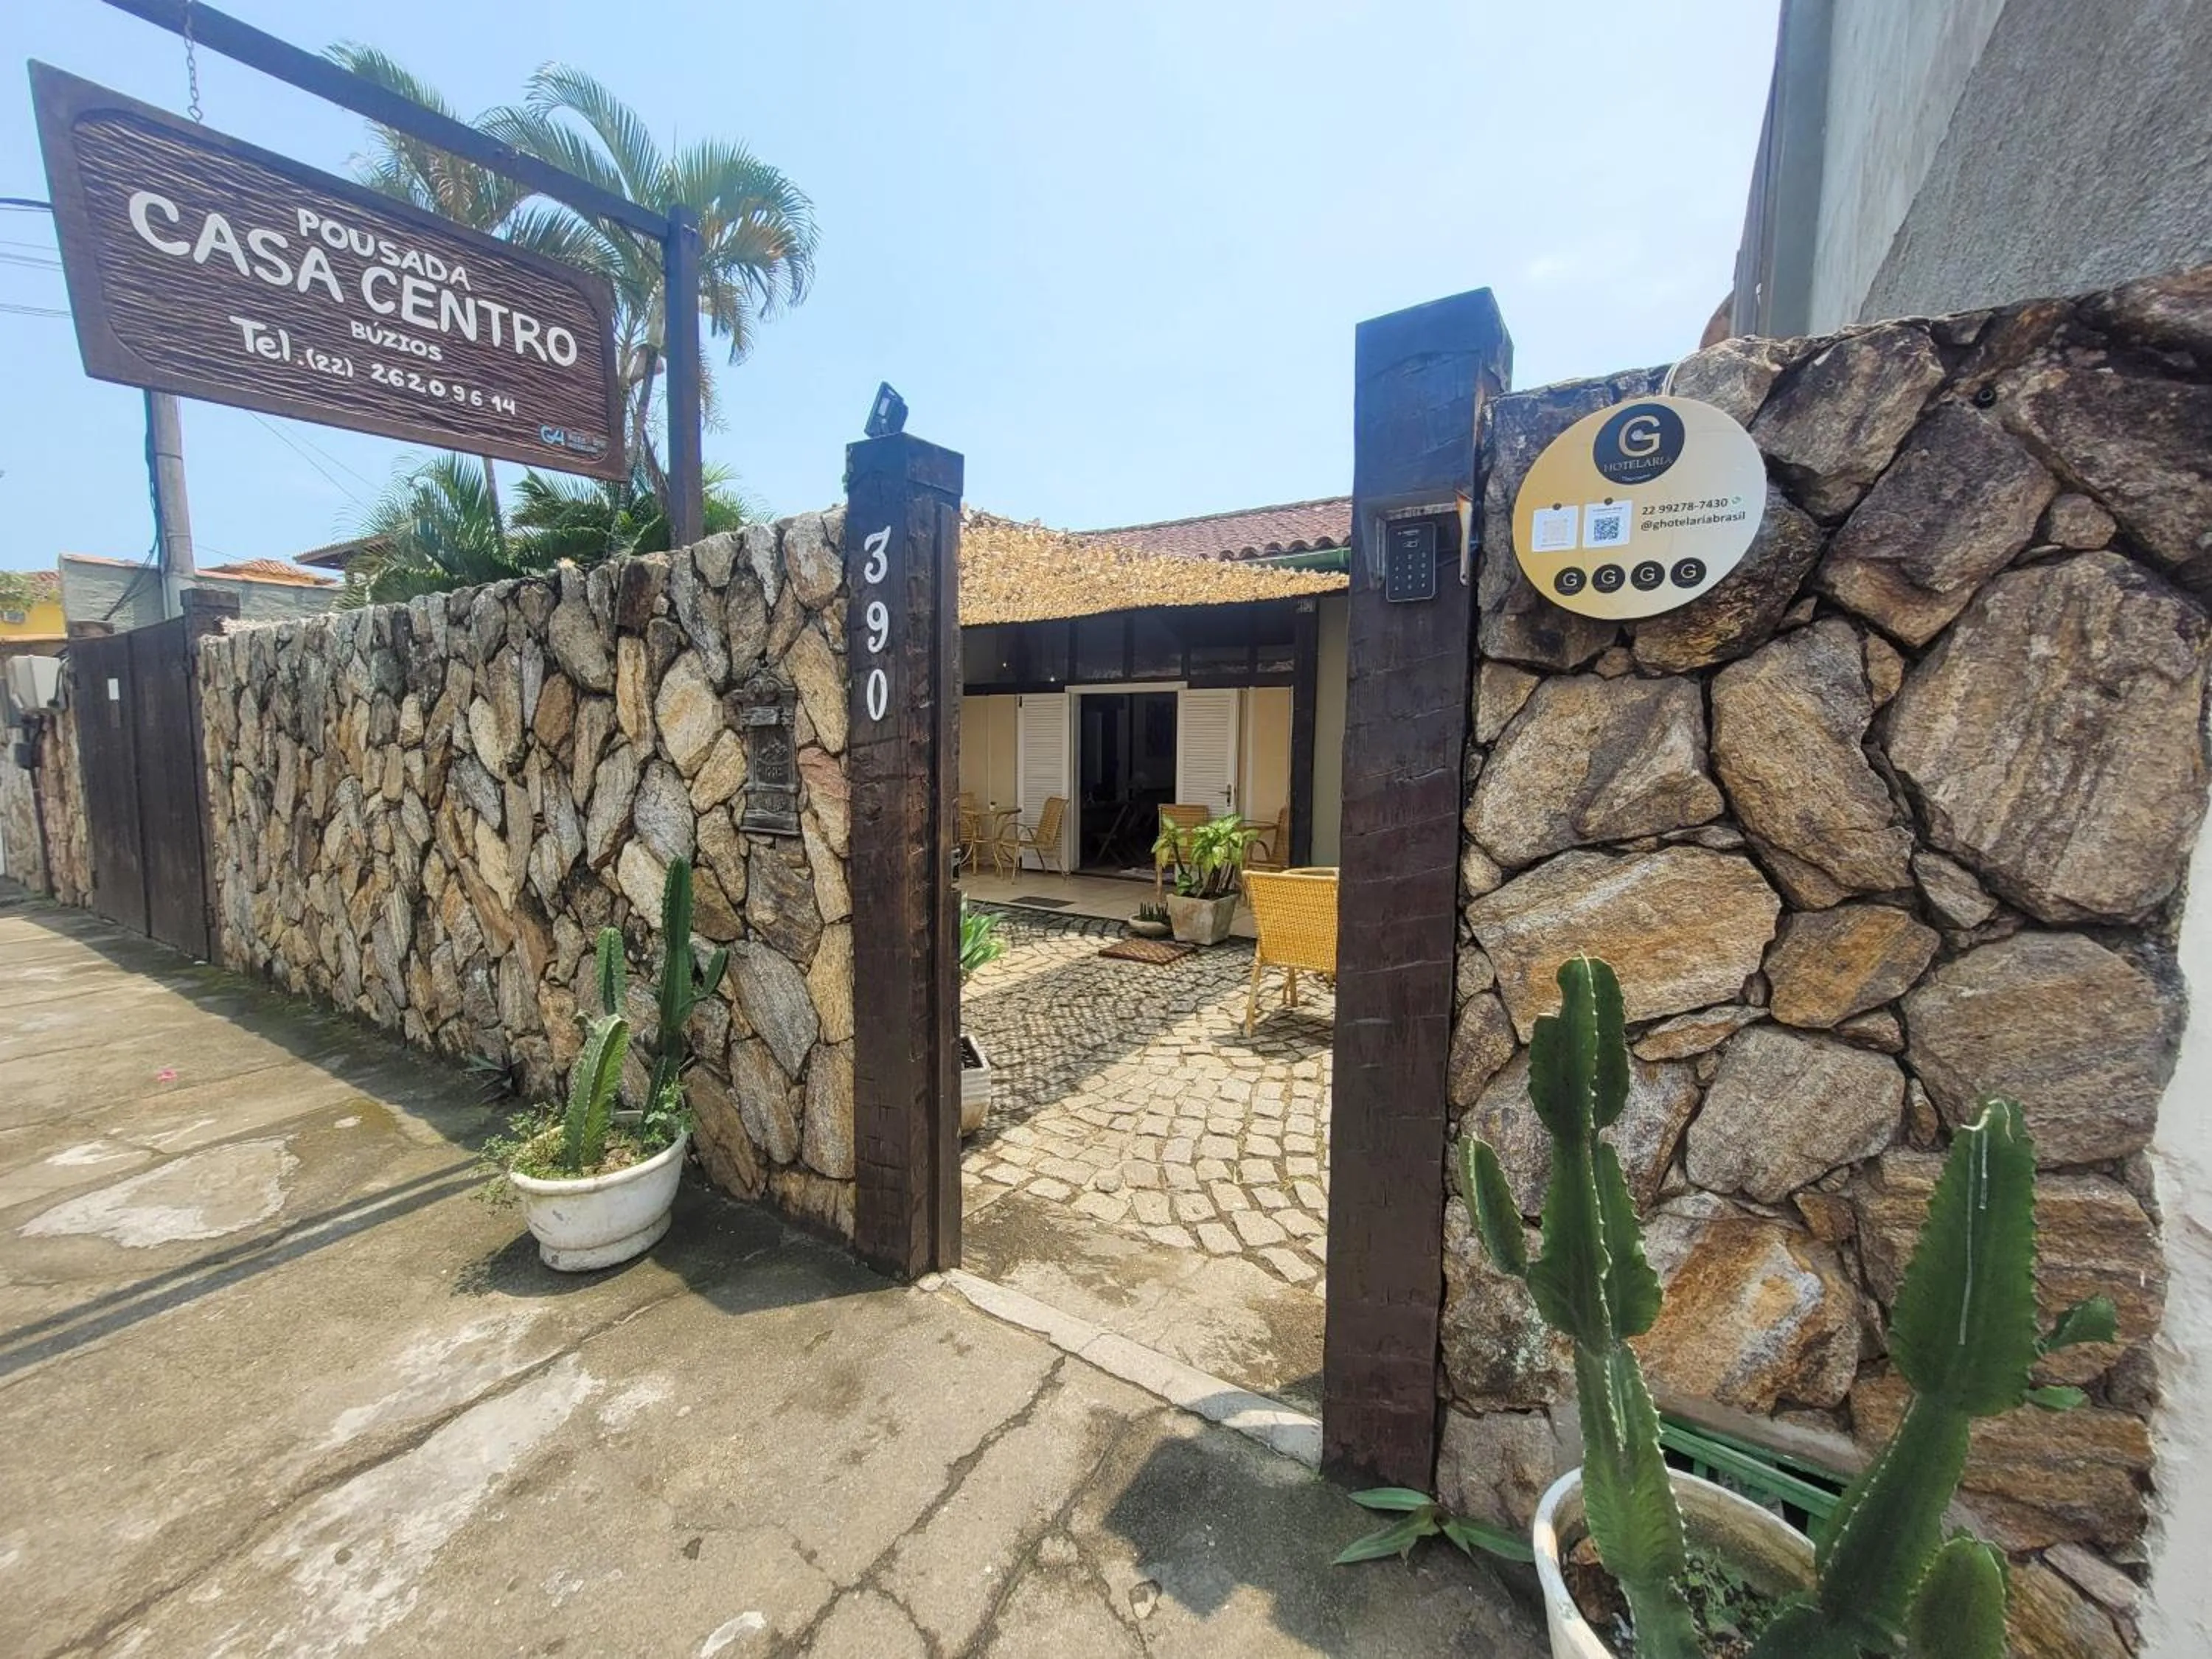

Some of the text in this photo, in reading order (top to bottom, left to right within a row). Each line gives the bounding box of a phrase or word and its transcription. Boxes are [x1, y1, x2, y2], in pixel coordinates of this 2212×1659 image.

[297, 207, 471, 291] POUSADA
[129, 191, 577, 367] CASA CENTRO
[350, 320, 443, 361] BÚZIOS
[1618, 415, 1660, 456] G
[1603, 456, 1674, 473] HOTELARIA
[1641, 498, 1728, 515] 22 99278-7430
[1641, 511, 1746, 532] @ghotelariabrasil
